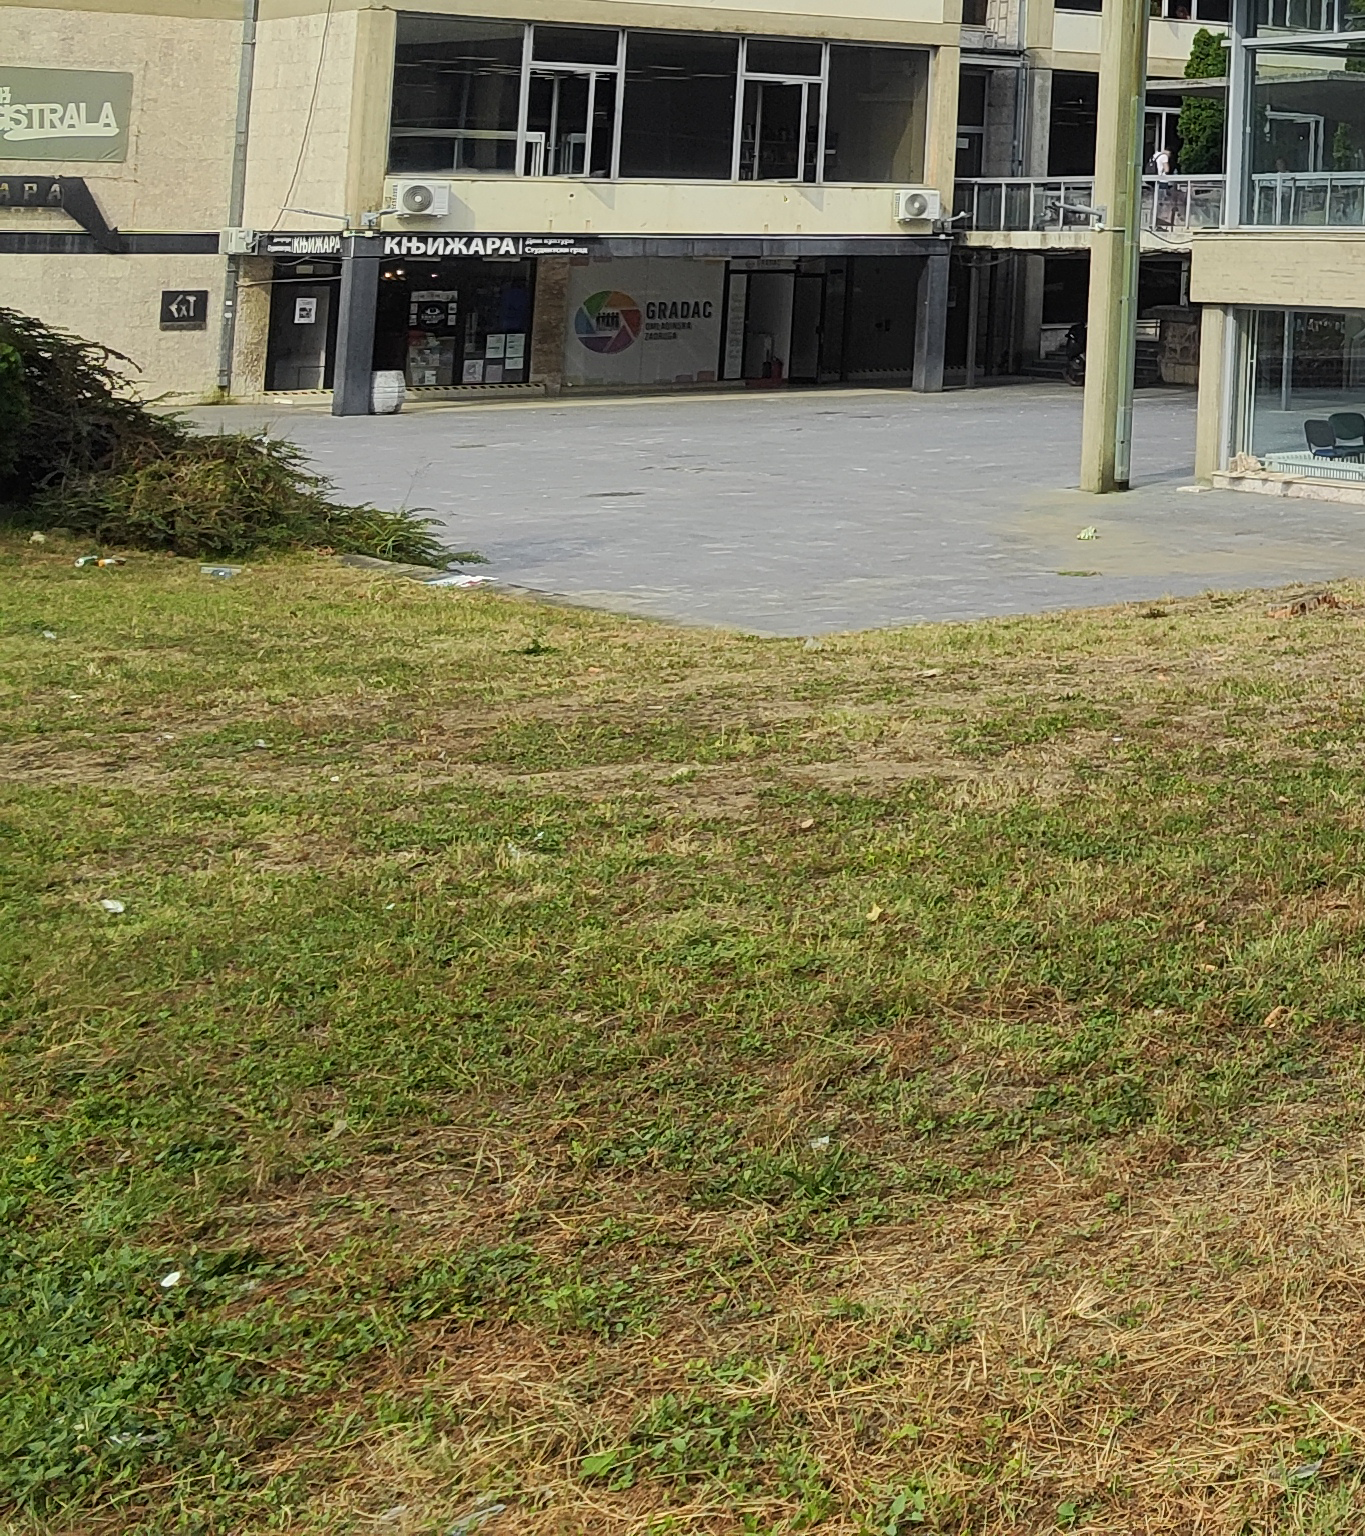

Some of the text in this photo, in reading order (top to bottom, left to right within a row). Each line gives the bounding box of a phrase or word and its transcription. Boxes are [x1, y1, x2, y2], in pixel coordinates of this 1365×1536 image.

[0, 102, 118, 132] ISTRALA
[292, 235, 341, 254] КЊИЖАРА
[383, 236, 517, 256] КЊИЖАРА
[645, 300, 713, 320] GRADAC
